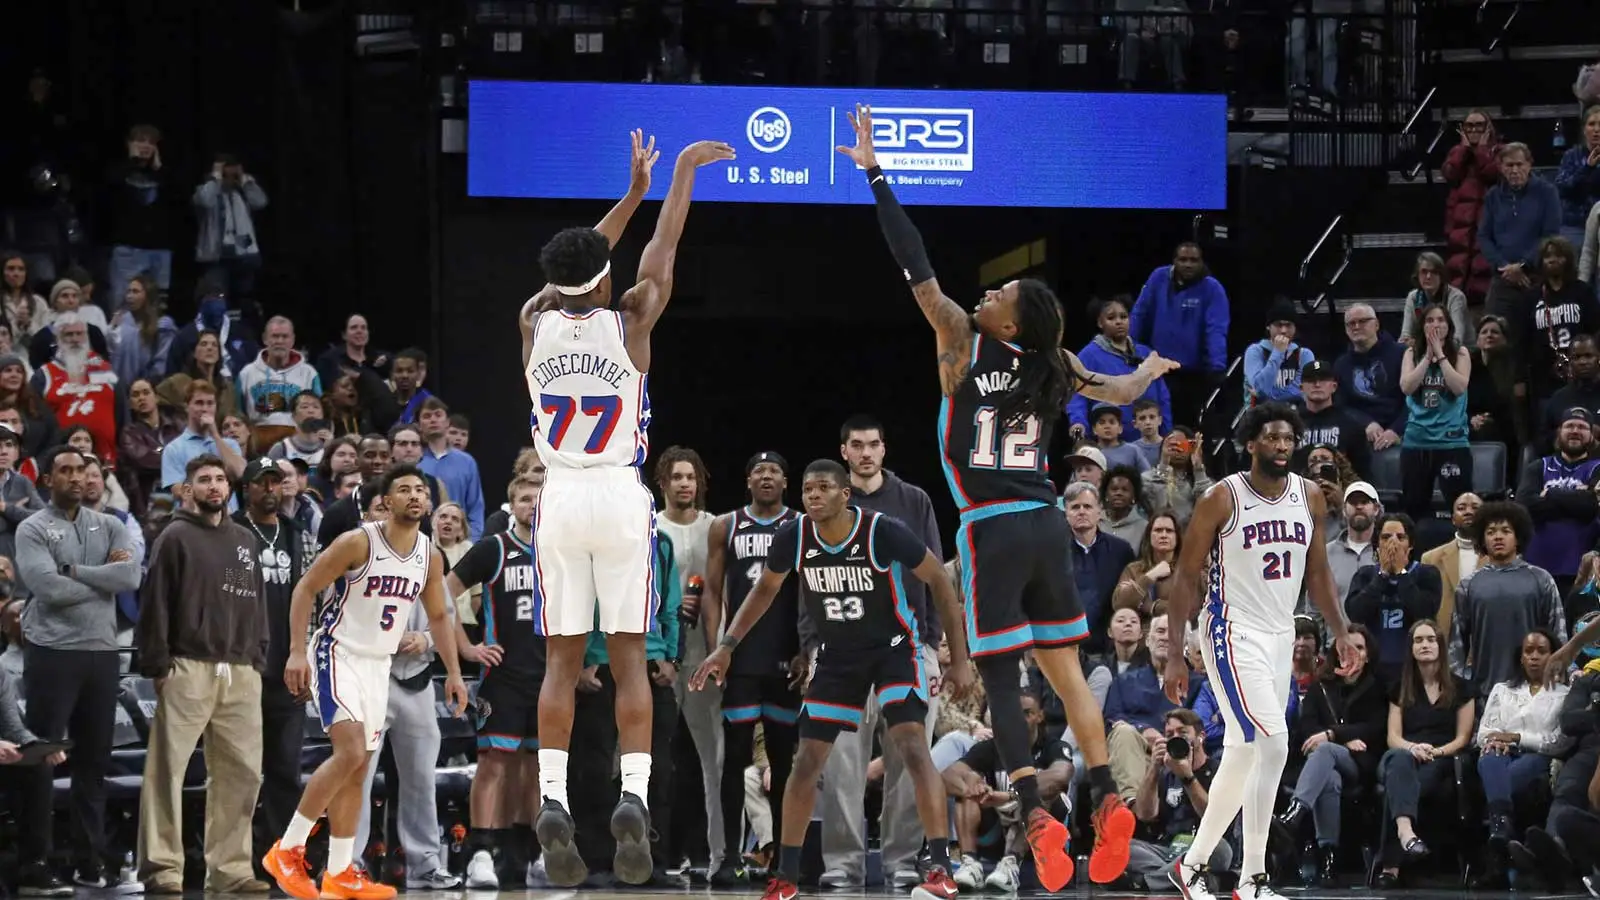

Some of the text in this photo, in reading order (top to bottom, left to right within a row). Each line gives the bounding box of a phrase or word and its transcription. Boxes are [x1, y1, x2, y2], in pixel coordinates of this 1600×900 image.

[752, 119, 786, 142] USS
[872, 118, 965, 149] BRS
[727, 167, 809, 185] U. S. Steel
[898, 176, 922, 185] Steel
[924, 177, 964, 187] company
[532, 353, 631, 389] EDGECOMBE
[540, 393, 623, 454] 77
[968, 405, 1042, 471] 12
[1242, 520, 1307, 549] PHILA
[1262, 550, 1291, 580] 21
[804, 566, 874, 593] MEMPHIS
[380, 605, 398, 631] 5
[823, 596, 865, 622] 23
[1382, 609, 1404, 629] 12
